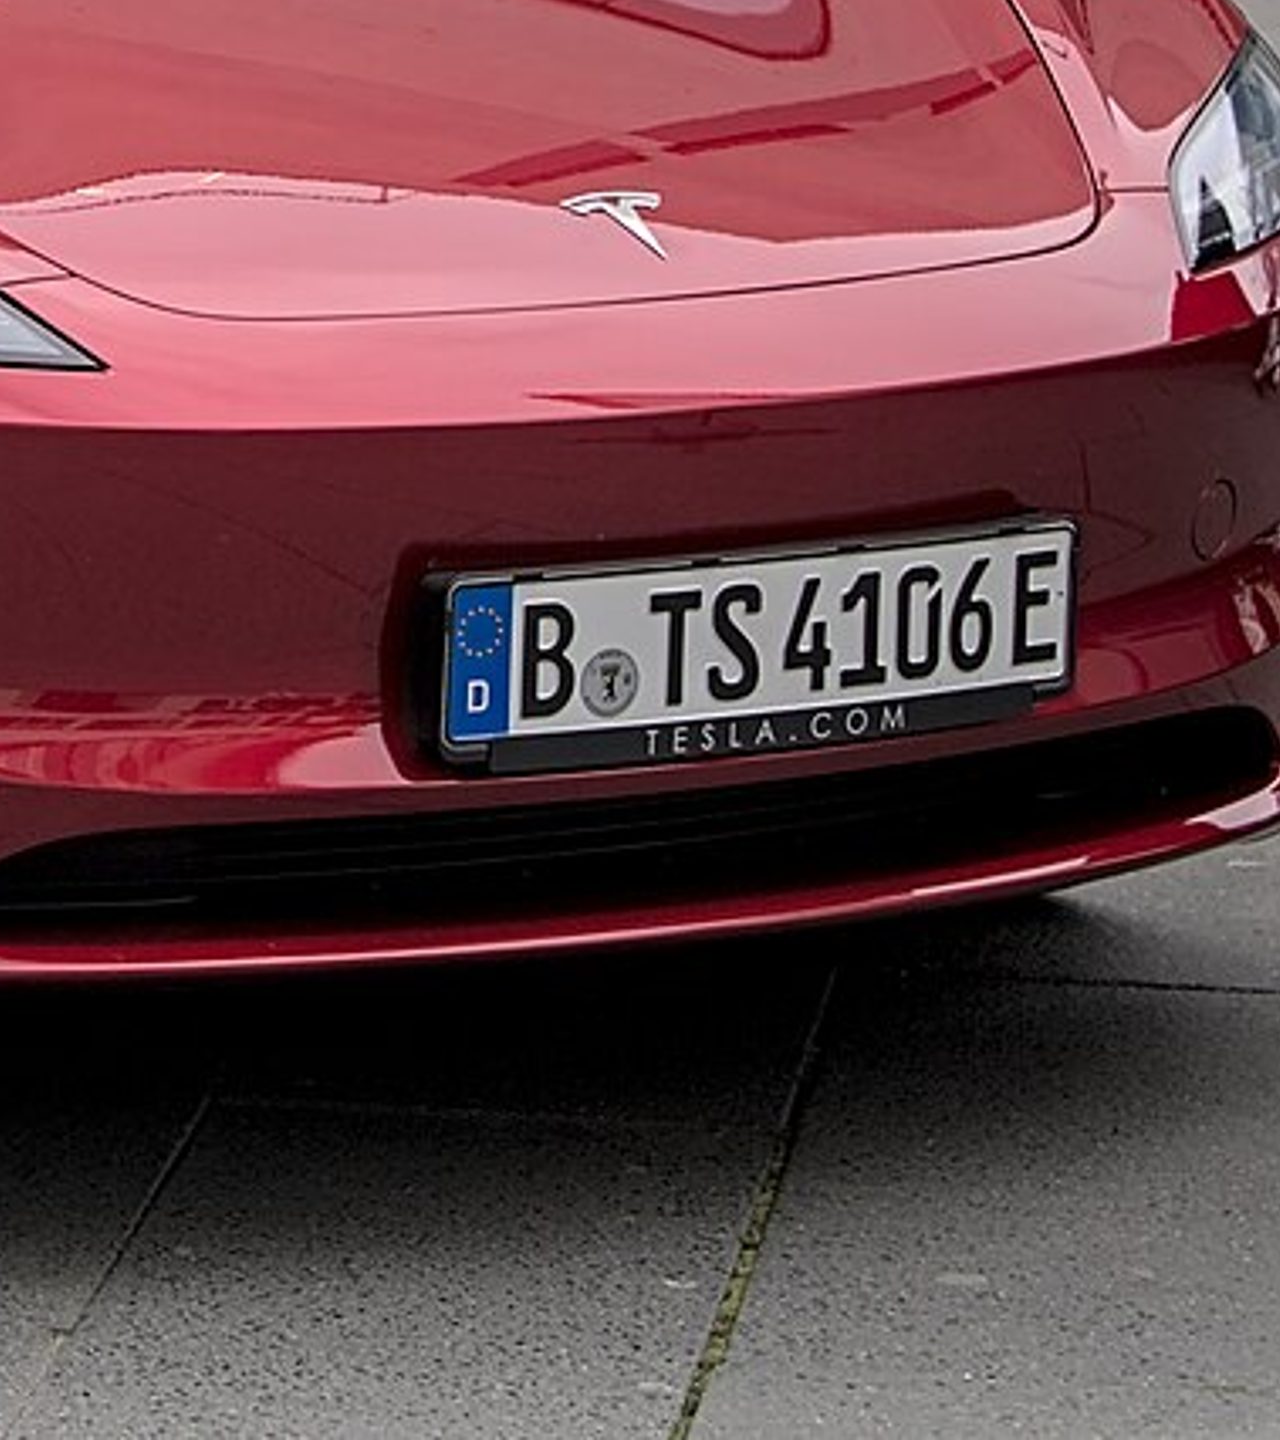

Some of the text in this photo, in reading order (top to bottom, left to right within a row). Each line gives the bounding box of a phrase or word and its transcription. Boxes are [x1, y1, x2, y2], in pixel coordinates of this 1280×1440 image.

[521, 602, 576, 719] B
[650, 583, 762, 706] TS
[467, 679, 490, 714] D
[645, 704, 906, 756] TESLA.COM
